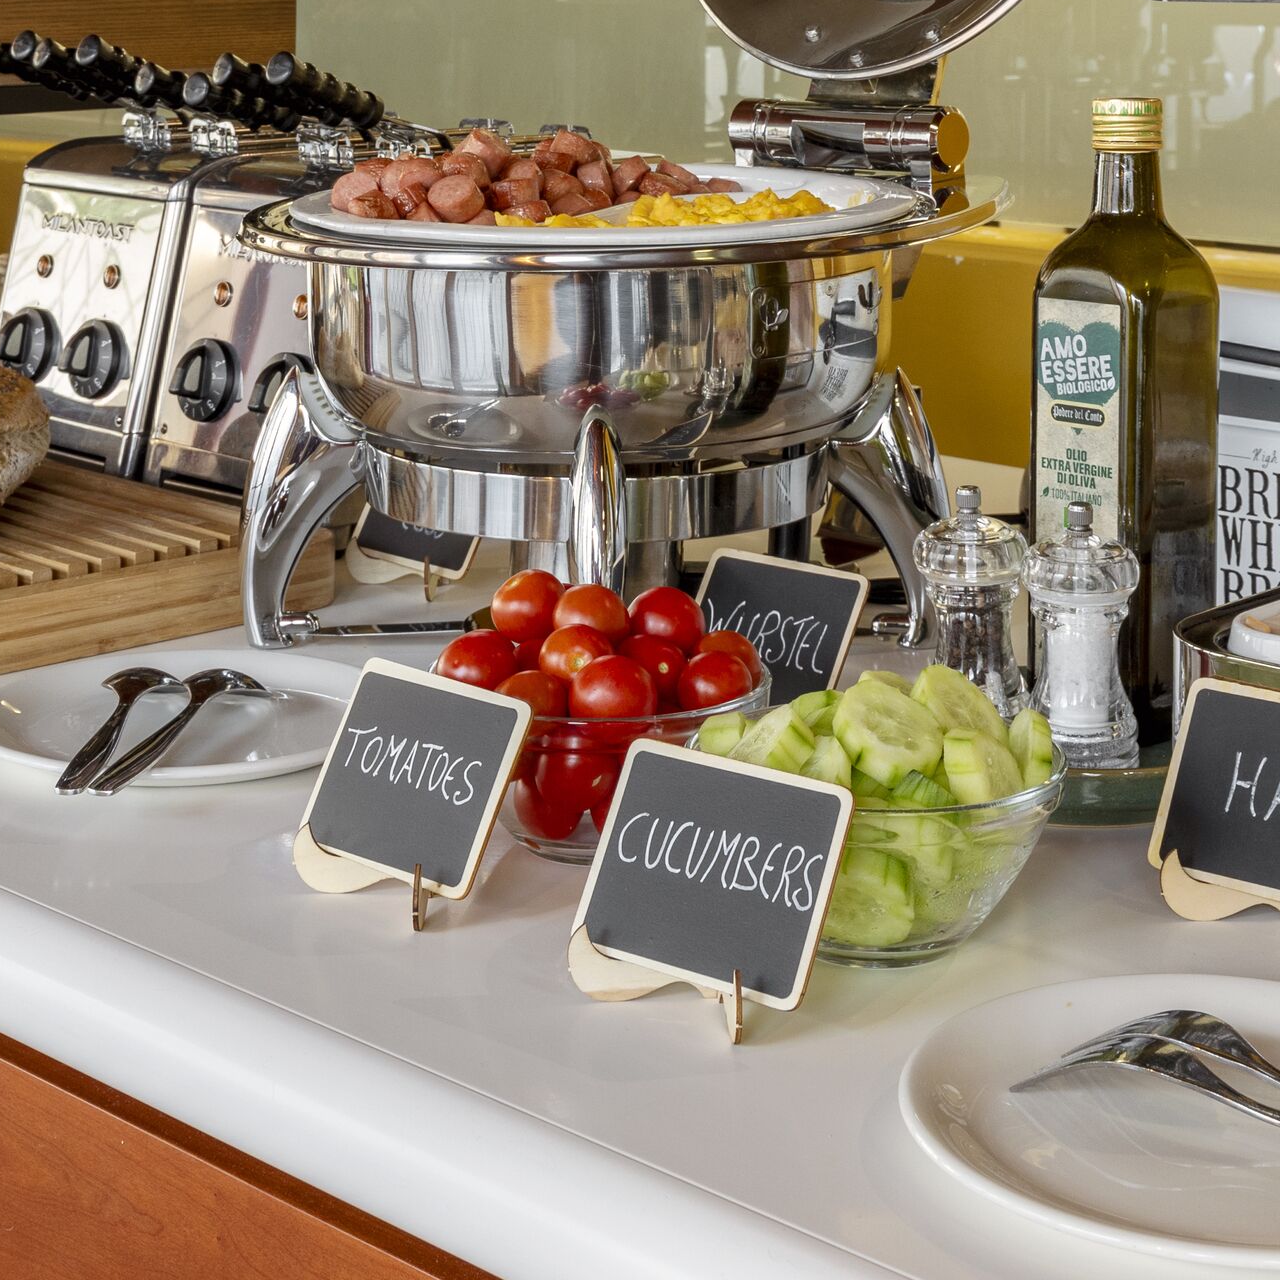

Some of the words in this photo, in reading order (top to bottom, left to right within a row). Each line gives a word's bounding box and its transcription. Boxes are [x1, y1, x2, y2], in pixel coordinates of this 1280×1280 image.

[42, 214, 135, 242] MILANTOAST
[1040, 334, 1087, 361] AMO
[1040, 355, 1113, 384] ESSERE
[1056, 379, 1109, 396] BIOLOGICO
[1074, 409, 1084, 420] del
[1066, 448, 1087, 462] OLIO
[1251, 447, 1278, 469] High
[1041, 457, 1071, 473] EXTRA
[1073, 462, 1113, 479] VERGINE
[1057, 472, 1067, 485] DI
[1068, 474, 1096, 489] OLIVA
[1051, 488, 1070, 500] 100%
[1071, 491, 1102, 507] ITALIANO
[347, 725, 483, 807] TOMATOES
[618, 811, 824, 913] CUCUMBERS
